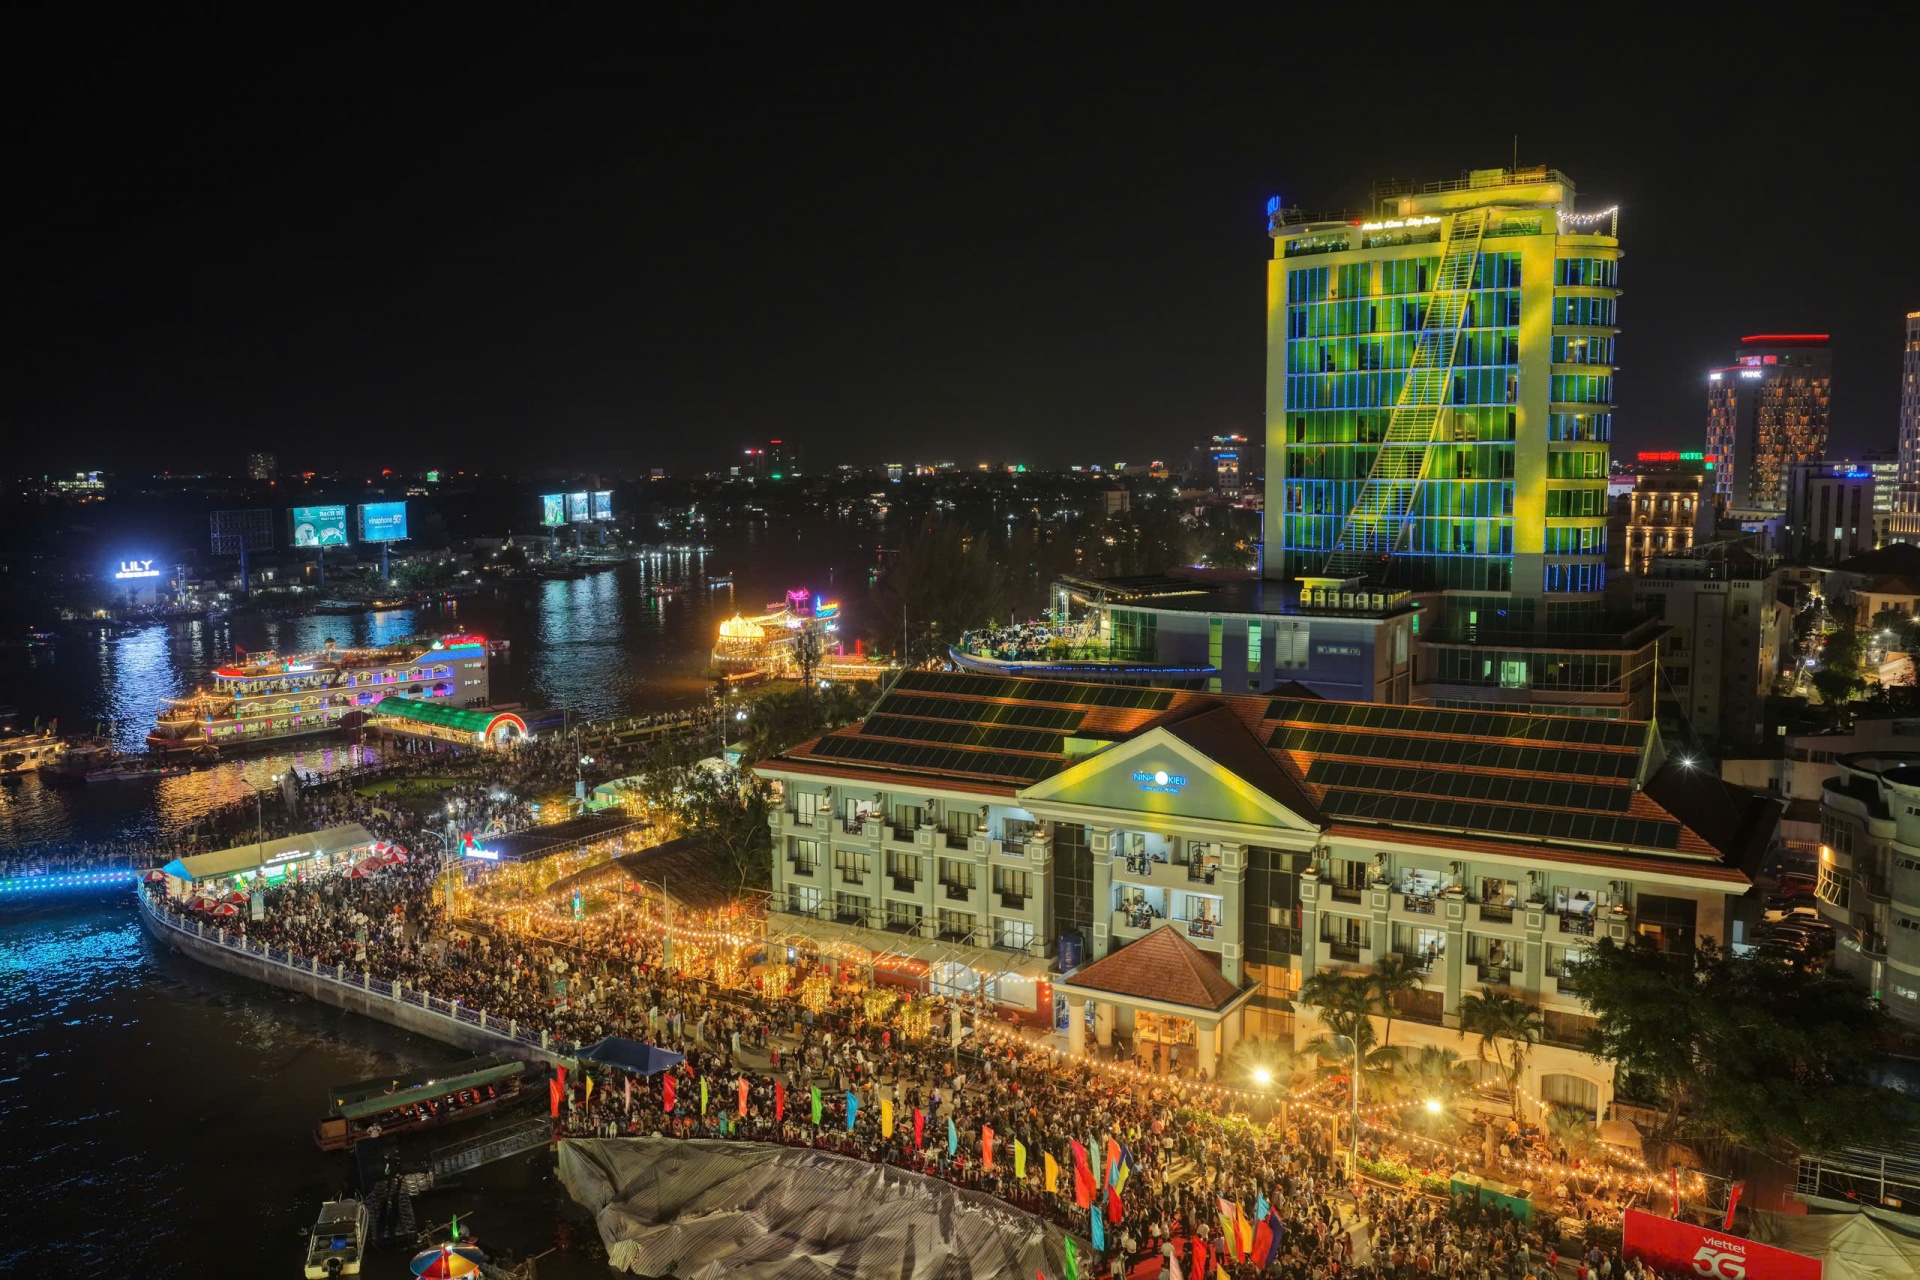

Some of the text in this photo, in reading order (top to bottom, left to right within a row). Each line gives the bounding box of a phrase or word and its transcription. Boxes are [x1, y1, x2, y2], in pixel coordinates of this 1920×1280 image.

[1680, 452, 1704, 460] HOTEL
[121, 560, 152, 572] LILY
[1702, 1236, 1747, 1255] viettel
[1693, 1246, 1747, 1280] 5G
